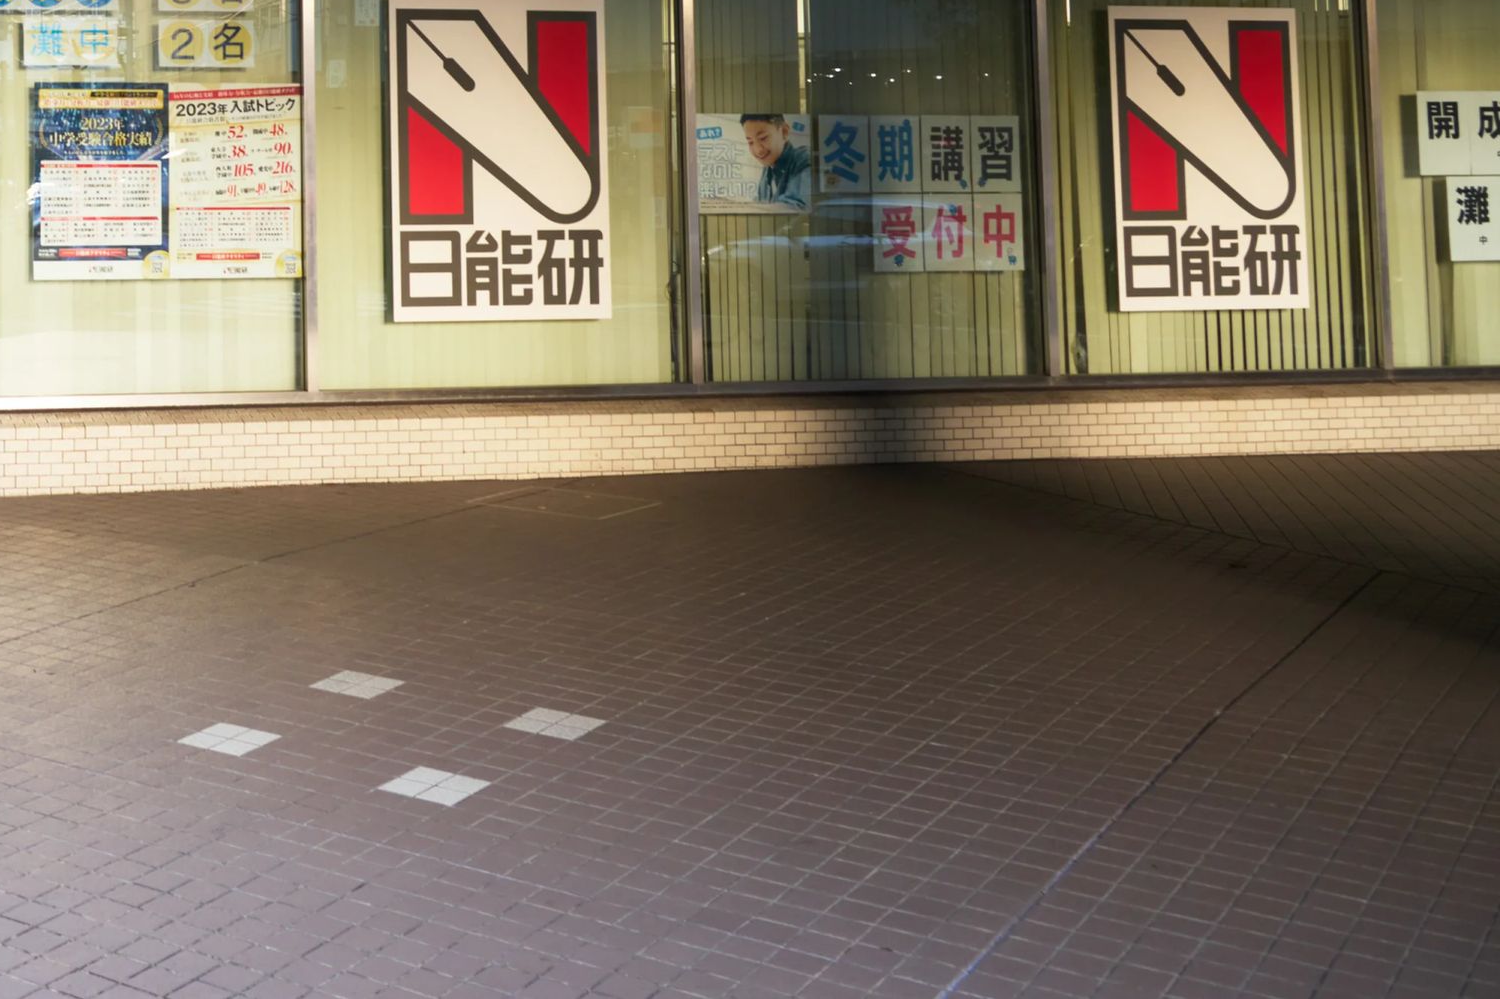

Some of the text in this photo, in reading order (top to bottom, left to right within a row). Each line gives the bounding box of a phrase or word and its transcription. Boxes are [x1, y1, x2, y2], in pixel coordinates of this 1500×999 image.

[30, 24, 244, 61] 灘中 2名
[176, 102, 228, 117] 2023年
[80, 117, 124, 130] 2023年
[50, 131, 152, 147] 中学受験合格実績
[698, 144, 743, 162] テスト
[824, 124, 1013, 184] 冬期講習
[700, 163, 741, 179] なのに
[1456, 186, 1490, 224] 灘
[881, 206, 1015, 260] 受付中
[1479, 236, 1488, 245] 中
[400, 228, 603, 306] 日能研
[1123, 225, 1301, 297] 日能研
